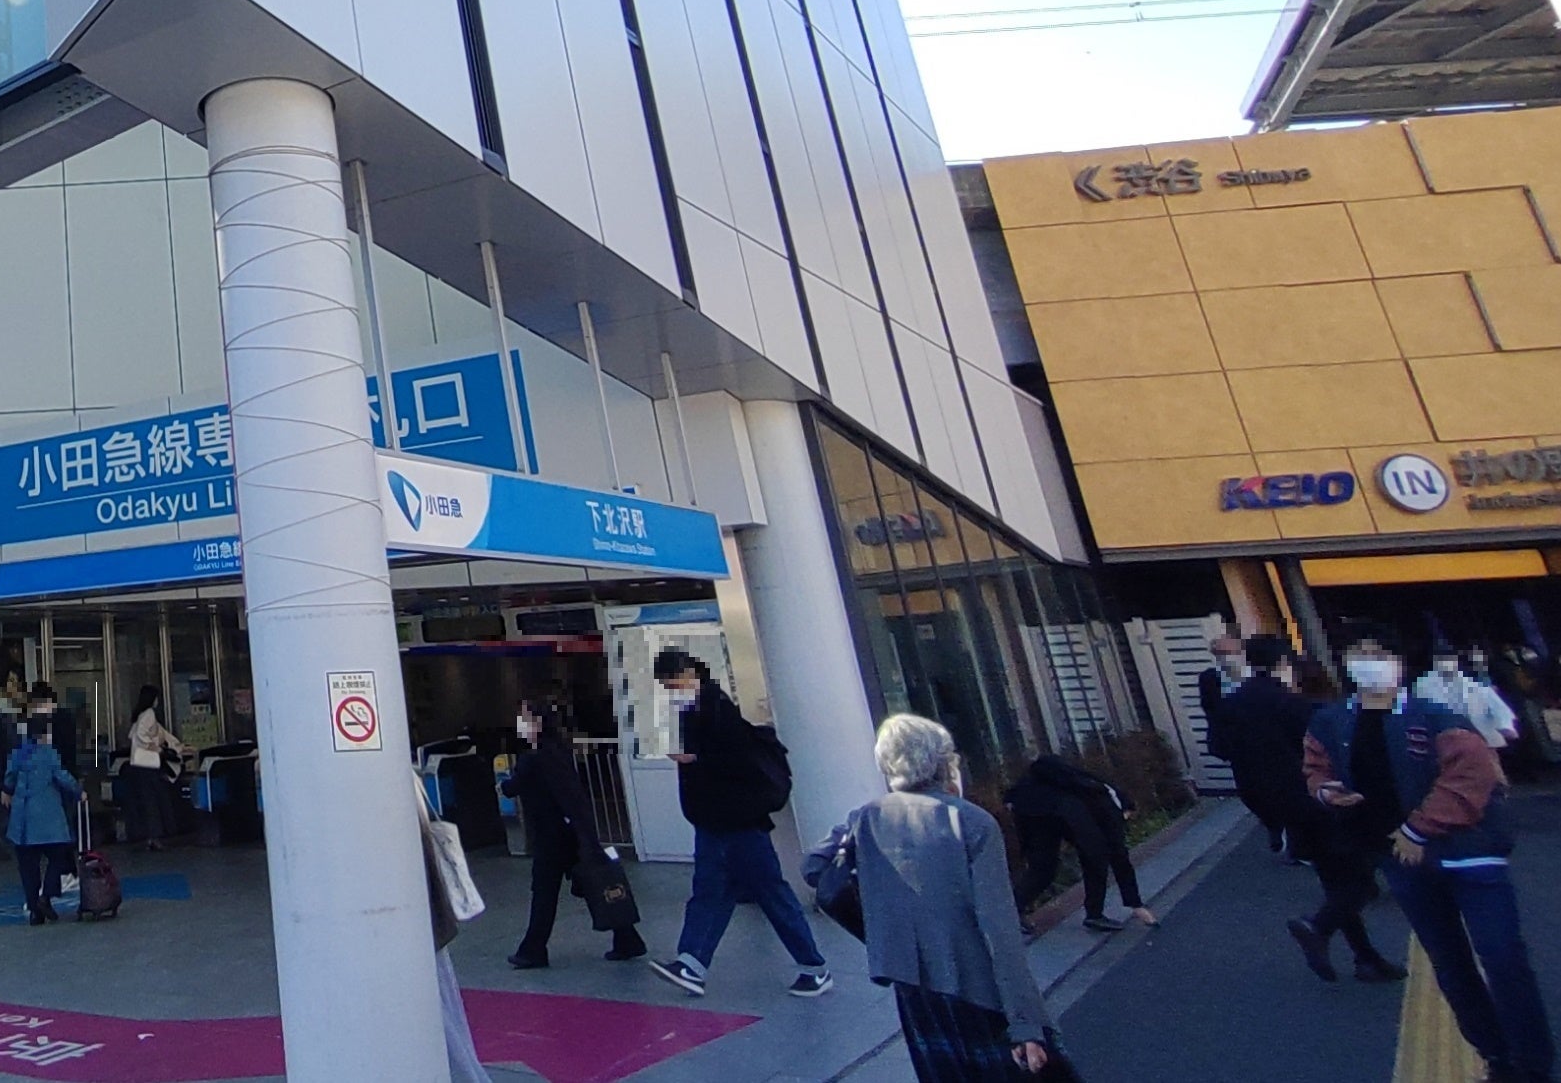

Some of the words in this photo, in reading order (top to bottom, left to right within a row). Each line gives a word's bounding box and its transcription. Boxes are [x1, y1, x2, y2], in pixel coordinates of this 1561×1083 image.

[1220, 470, 1354, 511] KEIO
[1391, 469, 1437, 496] IN
[96, 491, 198, 524] Odakyu
[425, 494, 464, 519] 小田急
[584, 500, 648, 539] 下北沢駅
